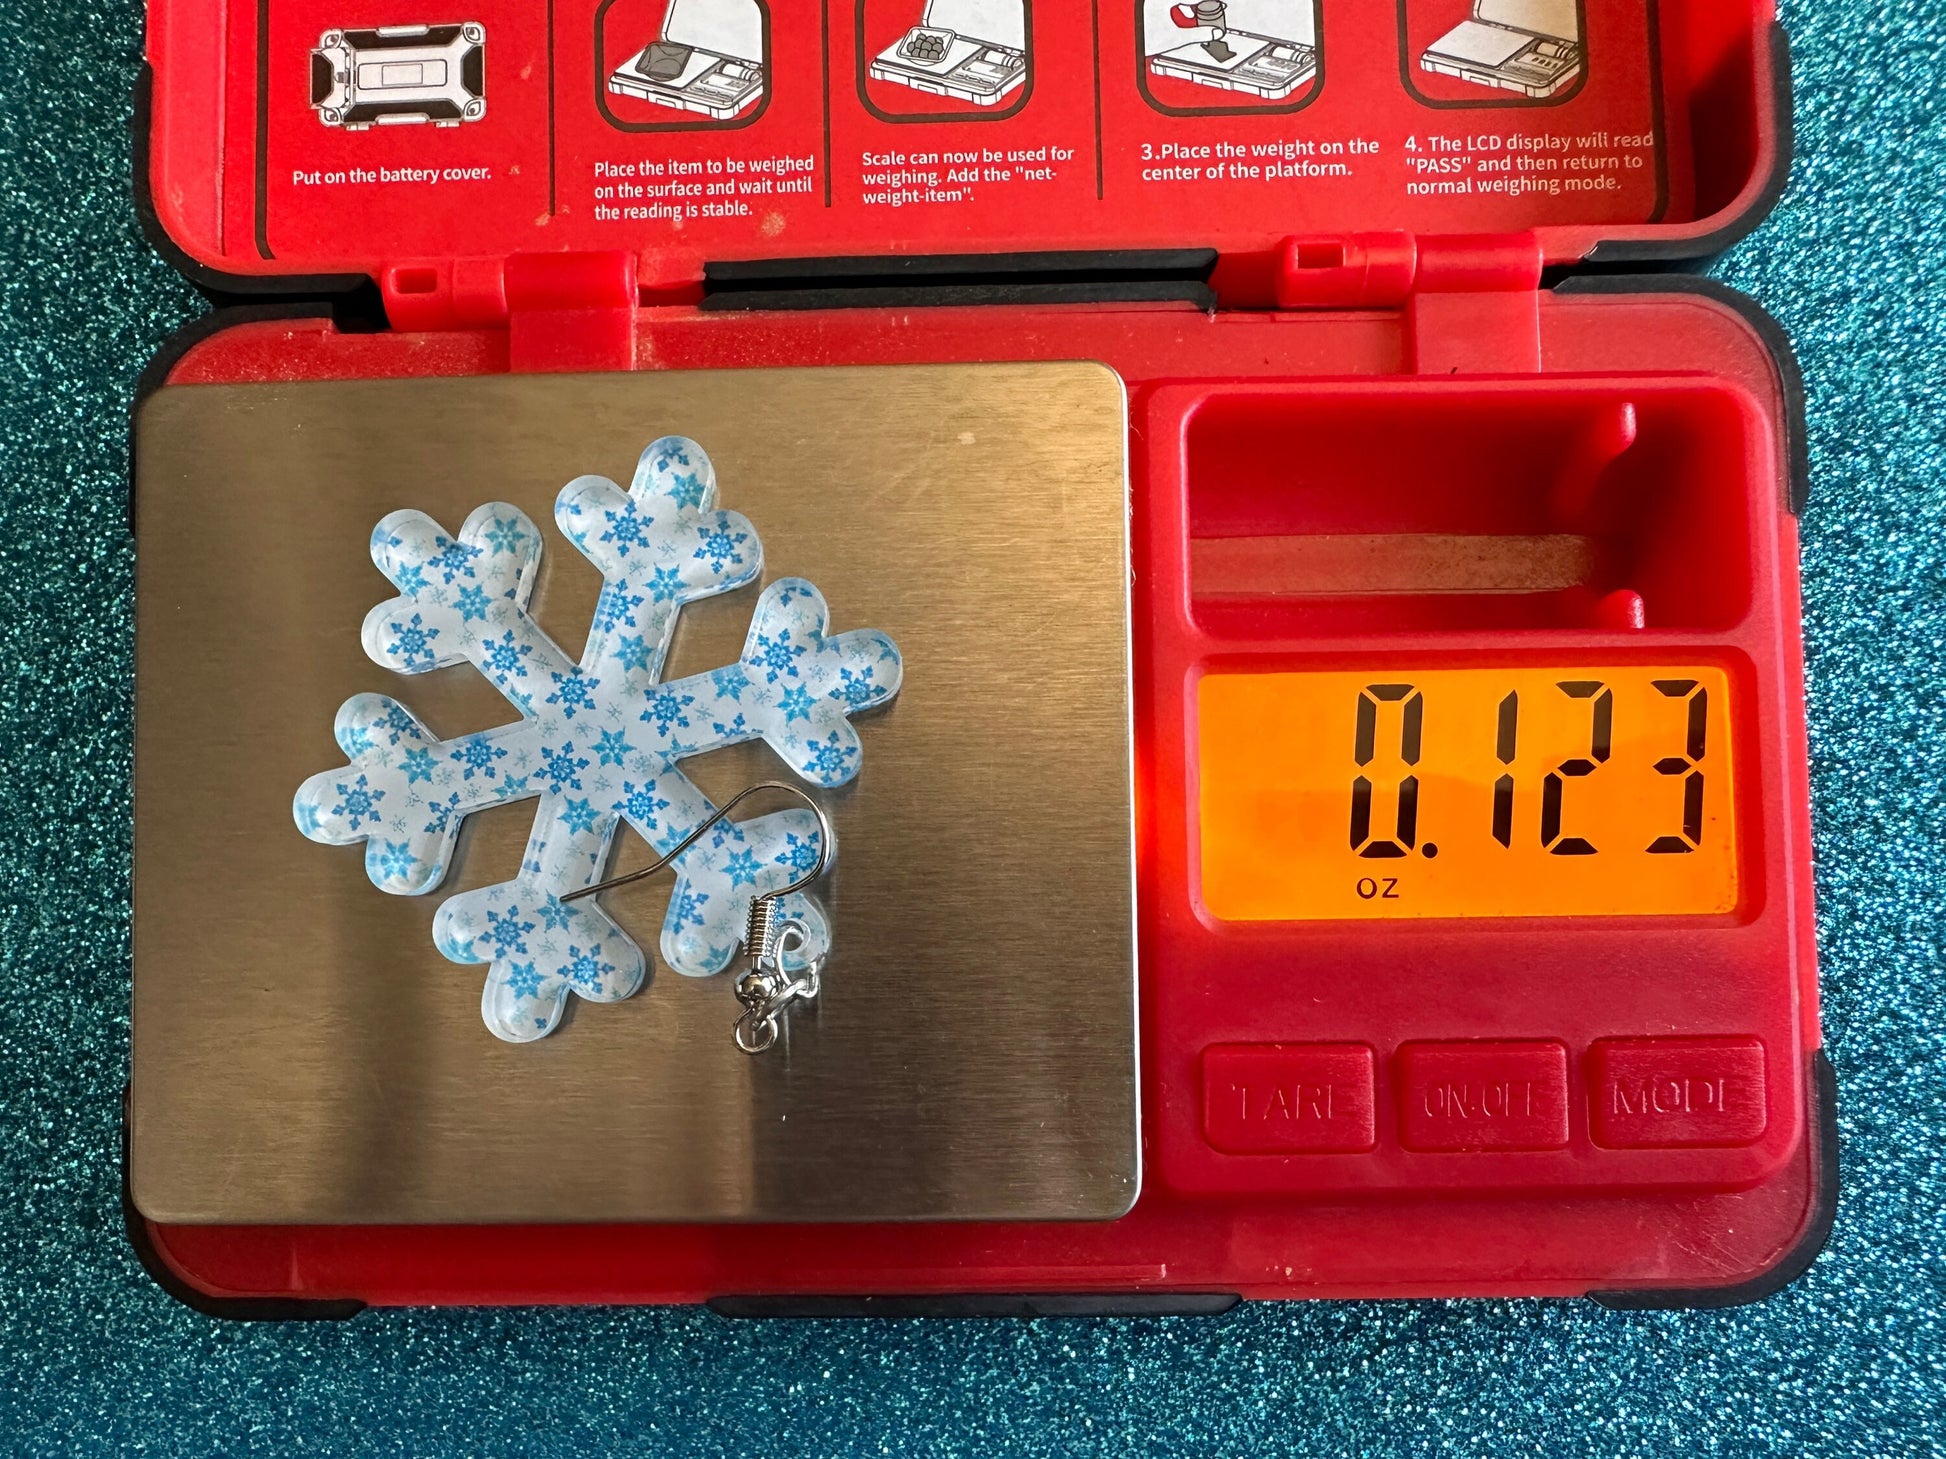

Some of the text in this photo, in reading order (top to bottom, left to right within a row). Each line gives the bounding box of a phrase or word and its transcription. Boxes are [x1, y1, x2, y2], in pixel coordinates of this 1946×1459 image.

[1214, 141, 1247, 158] the
[1250, 139, 1316, 160] weight
[1319, 142, 1344, 155] on
[1347, 137, 1380, 155] the
[1404, 135, 1423, 153] 4.
[1427, 135, 1462, 152] The
[1467, 134, 1502, 151] LCD
[1506, 133, 1572, 153] display
[1613, 130, 1654, 148] read
[594, 154, 815, 178] Place the item to be weighed
[862, 145, 1075, 167] Scale can now be used for
[1406, 154, 1643, 174] "PASS" and then return to
[292, 166, 492, 186] Put on the battery cover.
[862, 168, 942, 188] weighing.
[946, 167, 979, 183] Add
[983, 166, 1011, 182] the
[1141, 159, 1353, 182] center of the platform.
[594, 175, 813, 200] on the surface and wait until
[1406, 174, 1622, 197] normal weighing mode.
[594, 199, 753, 222] the reading is stable.
[1350, 679, 1708, 859] 0.123
